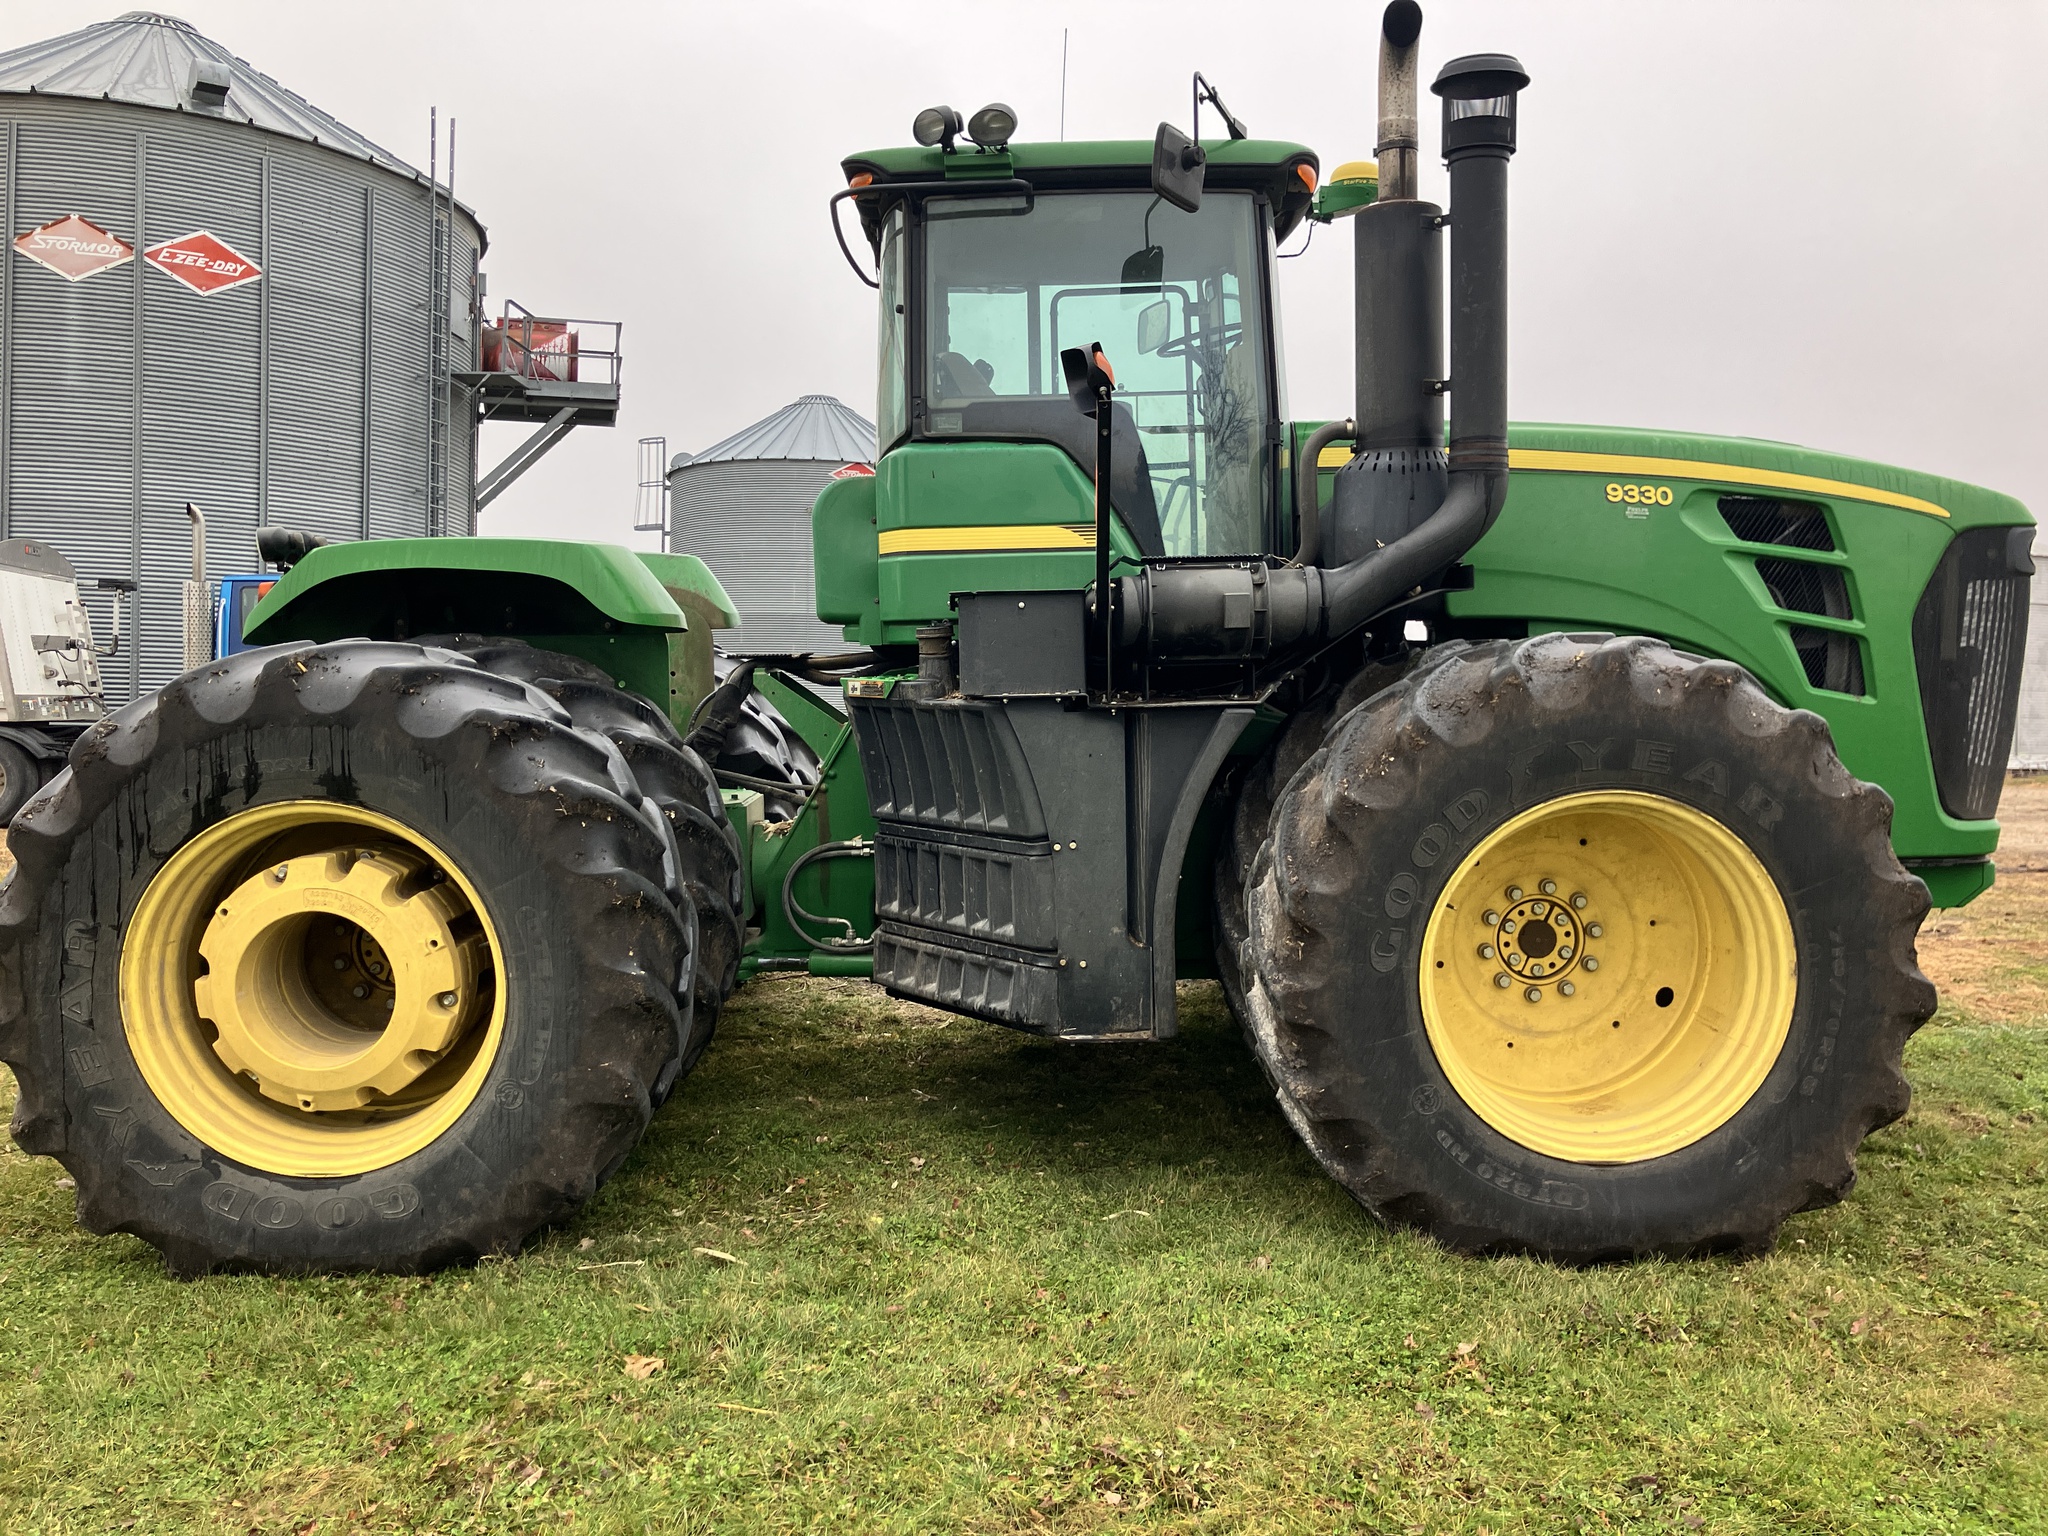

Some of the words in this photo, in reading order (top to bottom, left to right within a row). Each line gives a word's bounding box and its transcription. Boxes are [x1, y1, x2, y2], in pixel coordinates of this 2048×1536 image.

[29, 235, 124, 258] STORMOR
[157, 248, 248, 277] EZEE-DRY
[1605, 482, 1673, 506] 9330
